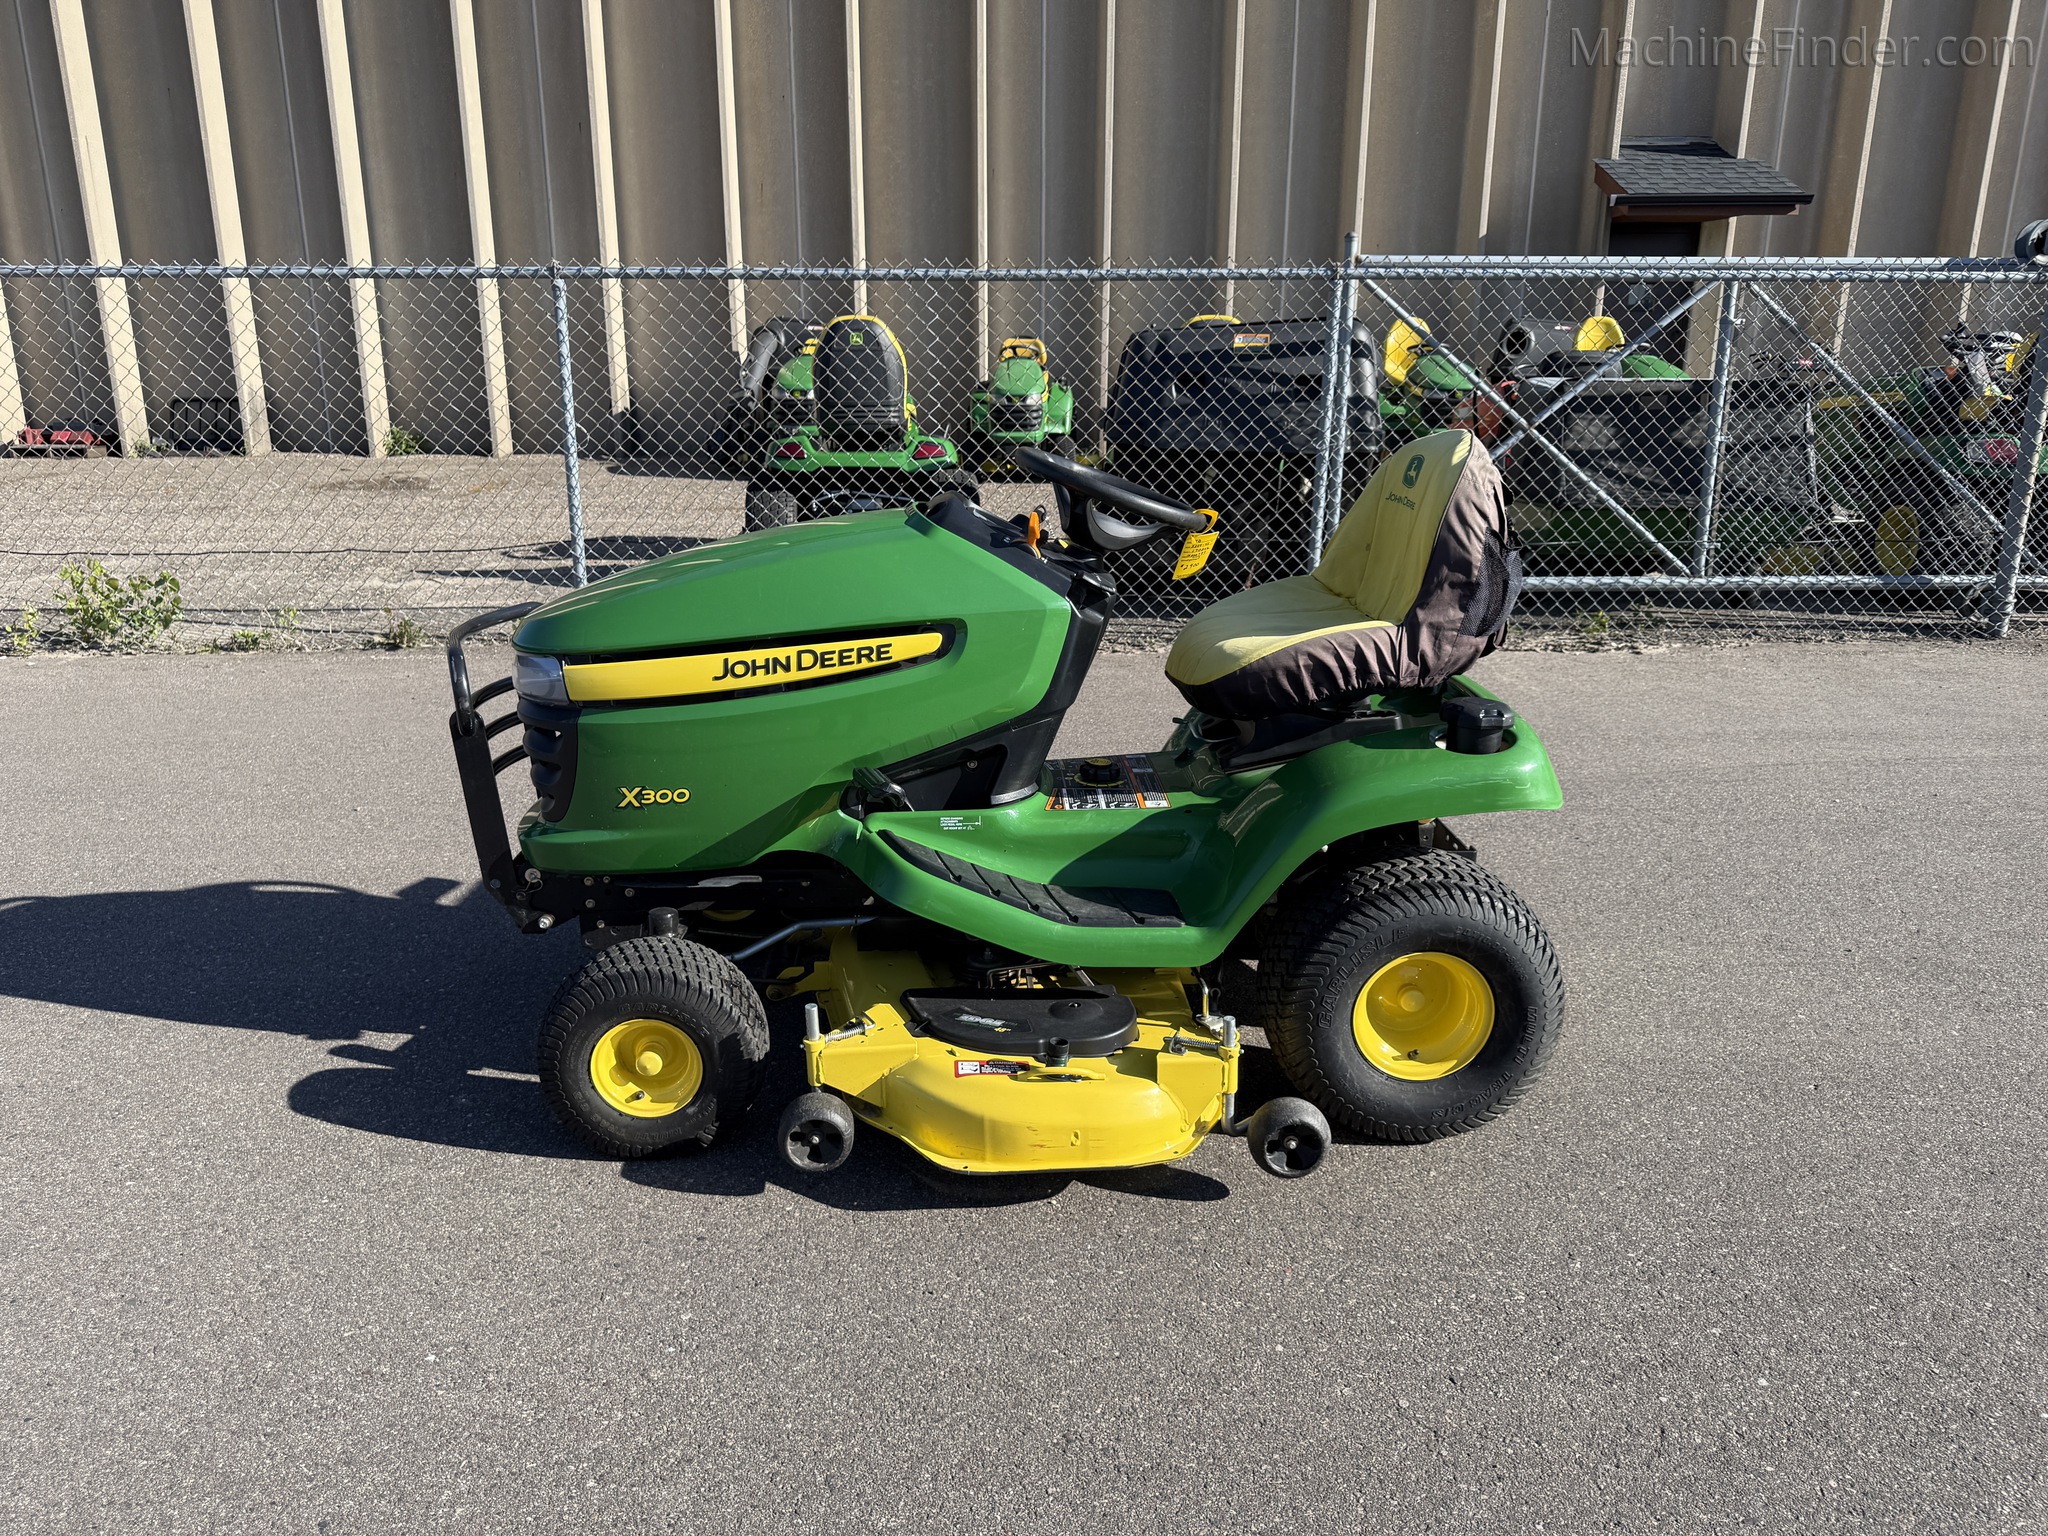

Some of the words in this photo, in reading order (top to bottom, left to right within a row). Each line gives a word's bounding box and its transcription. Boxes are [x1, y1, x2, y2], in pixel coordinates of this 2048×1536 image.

[1385, 491, 1403, 504] JOHN
[1403, 496, 1416, 511] DEERE
[712, 656, 791, 681] JOHN
[797, 643, 893, 672] DEERE
[616, 786, 692, 809] X300
[1318, 926, 1410, 1028] CARLISLE
[1515, 1006, 1538, 1066] MULTI
